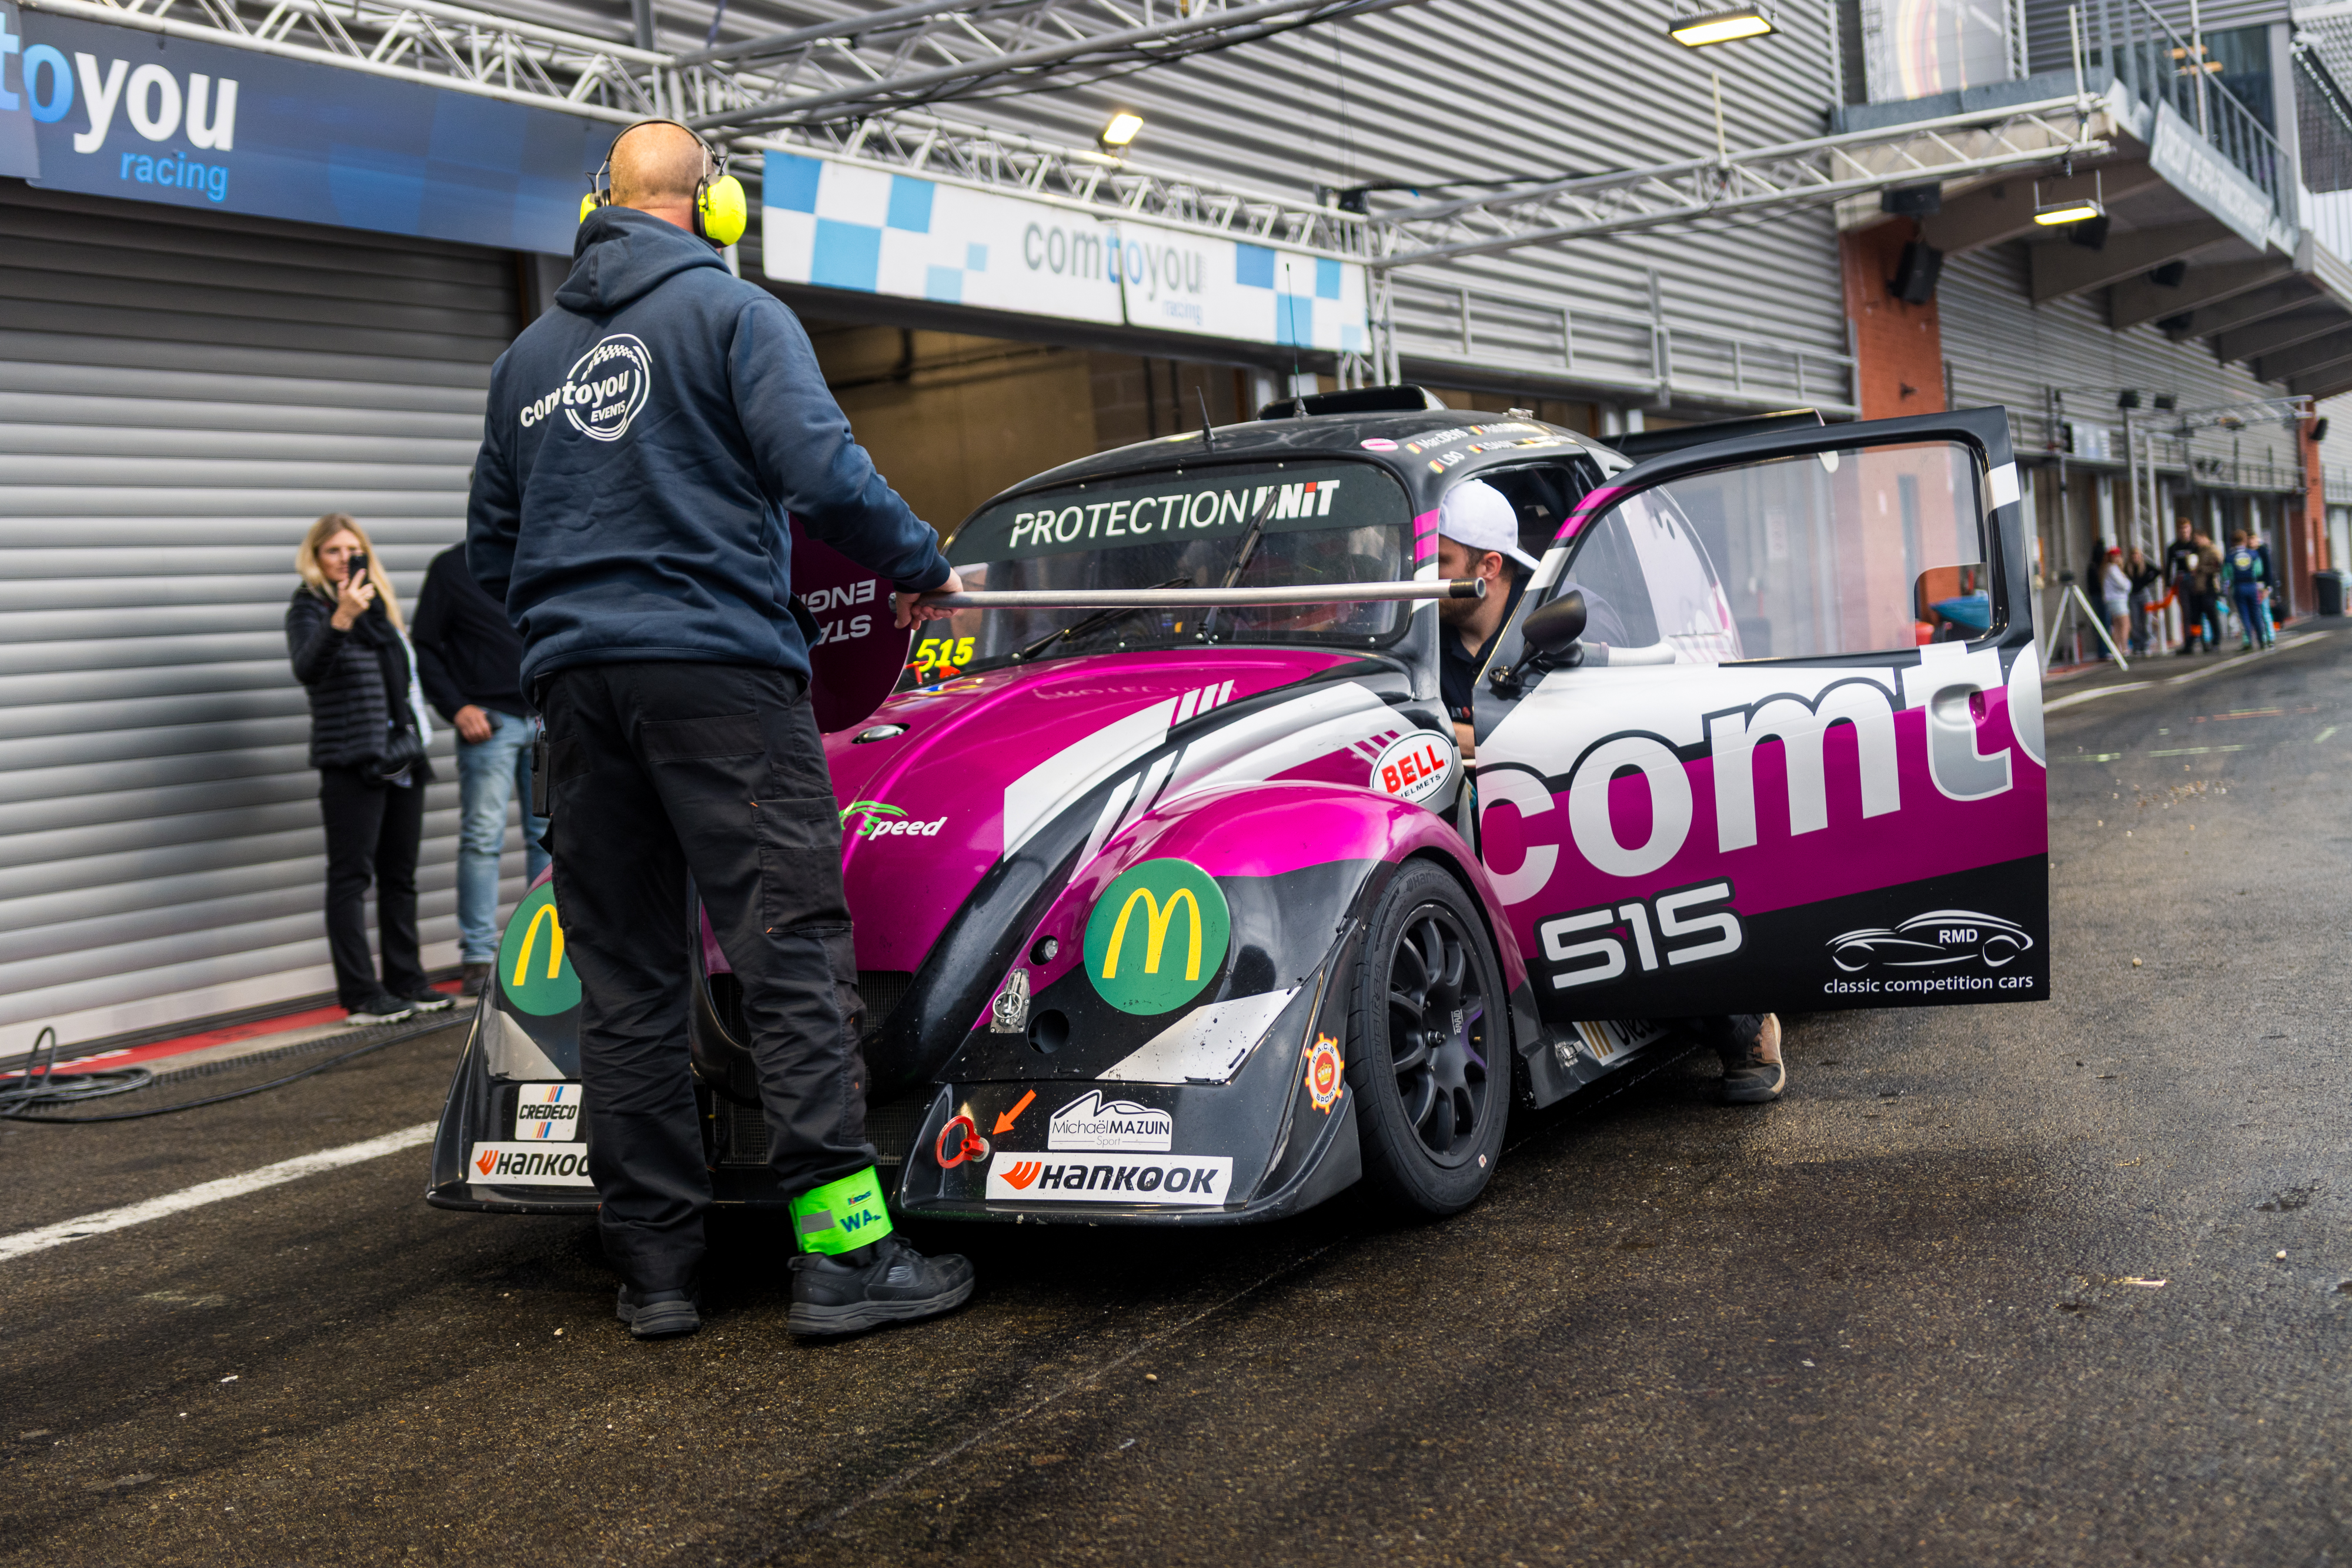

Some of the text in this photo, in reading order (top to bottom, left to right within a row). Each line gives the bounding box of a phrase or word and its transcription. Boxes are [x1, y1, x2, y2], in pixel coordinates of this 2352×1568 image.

[120, 152, 229, 203] racing
[1023, 222, 1202, 302] comtoyou
[1163, 297, 1203, 325] racing
[520, 370, 629, 427] comtoyou
[591, 400, 626, 423] EVENTS
[1009, 488, 1250, 548] PROTECTION
[816, 614, 872, 646] STA
[916, 637, 976, 673] 515
[1381, 744, 1445, 794] BELL
[856, 812, 948, 841] Speed
[1540, 882, 1742, 989] 515
[1939, 929, 1978, 944] RMD
[1824, 975, 2033, 994] classic competition cars
[1316, 1085, 1336, 1103] SPORT
[519, 1104, 578, 1120] CREDECO
[1097, 1135, 1121, 1148] Sport
